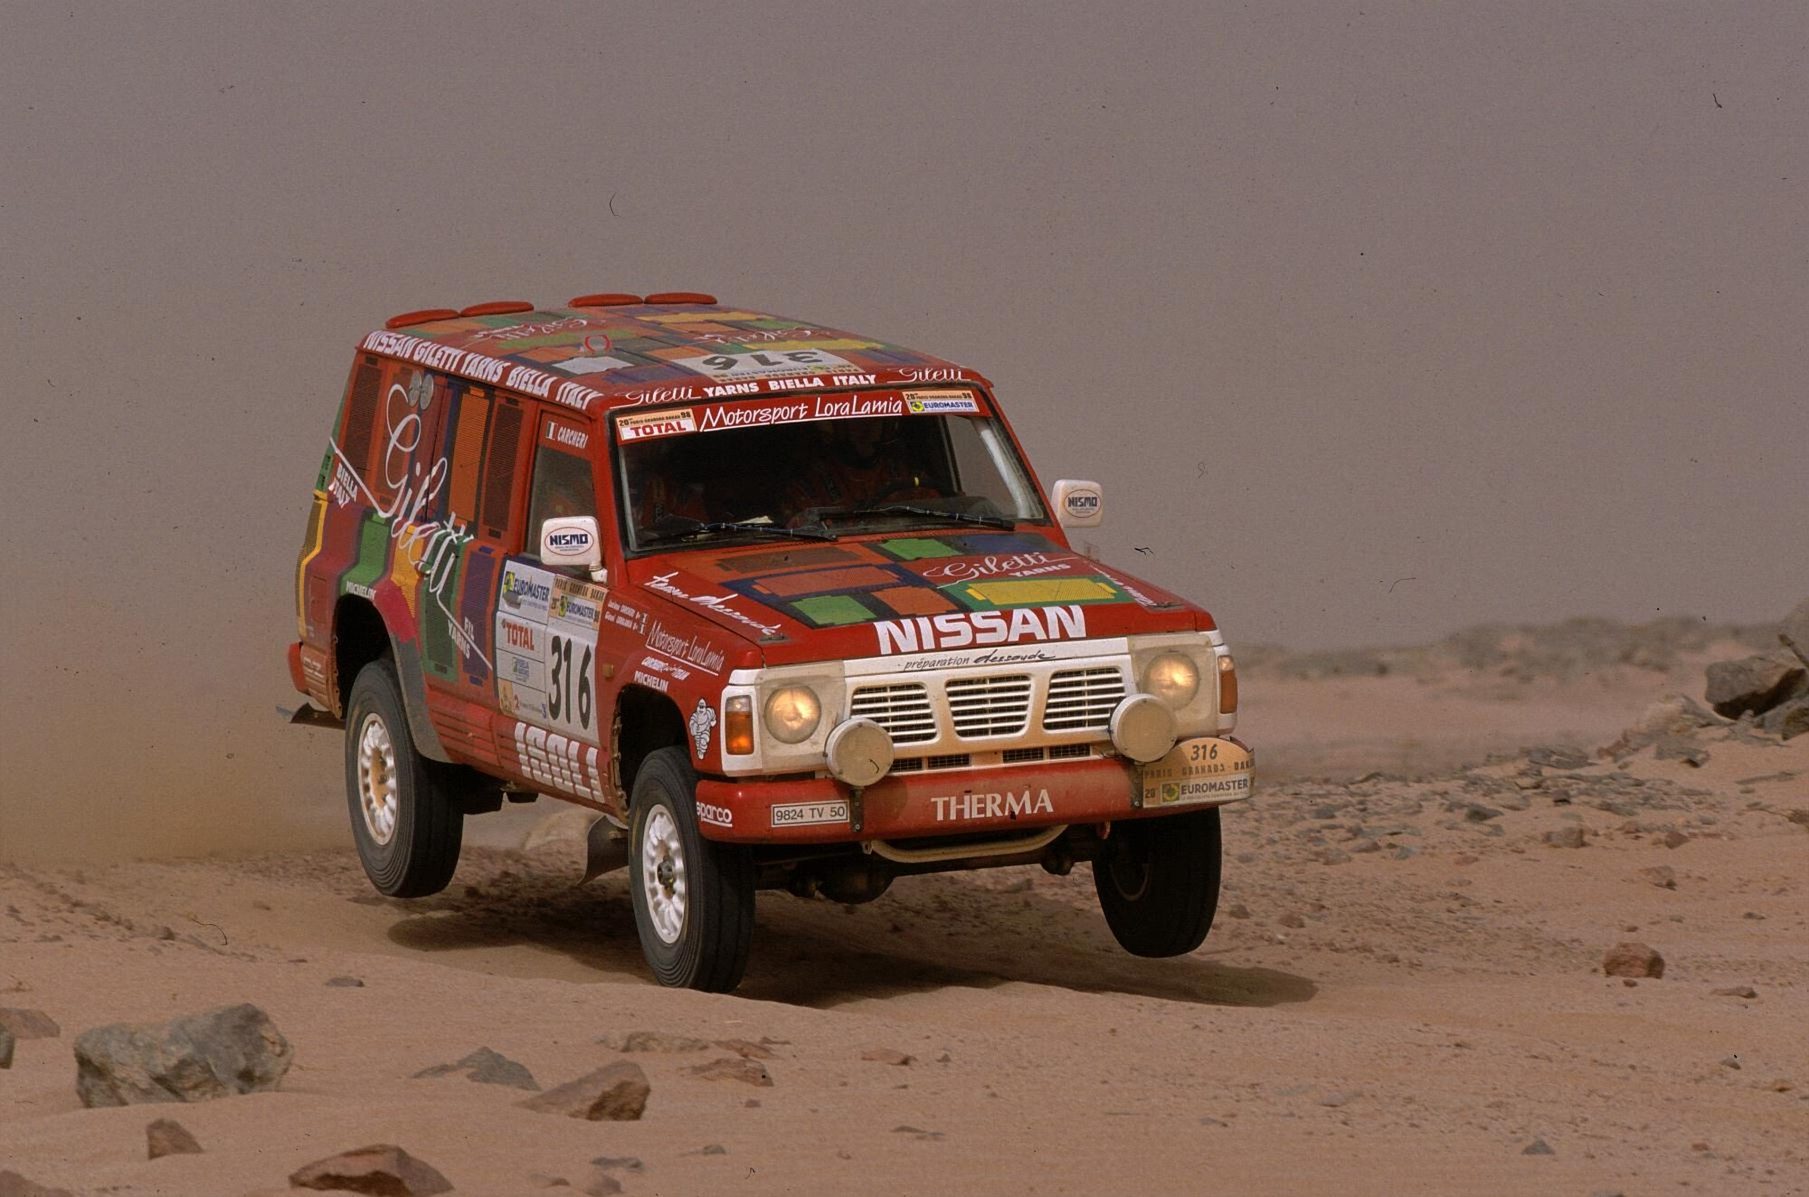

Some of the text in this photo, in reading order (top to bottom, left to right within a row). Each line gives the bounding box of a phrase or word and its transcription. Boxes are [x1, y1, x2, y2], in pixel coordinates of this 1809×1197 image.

[363, 330, 424, 358] NISSAN
[413, 341, 468, 372] GILETTI
[460, 352, 511, 383] YARNS
[505, 366, 558, 398] BIELLA
[555, 382, 604, 410] ITALY
[703, 383, 760, 397] YARNS
[768, 377, 824, 391] BIELLA
[833, 375, 876, 386] ITALY
[630, 421, 686, 436] TOTAL
[700, 405, 808, 432] Motorsport
[1068, 496, 1098, 507] NISMO
[550, 534, 588, 546] NISMO
[923, 552, 1079, 589] Giletti
[1008, 563, 1071, 577] YARNS
[346, 581, 376, 600] MICHELIN
[514, 578, 550, 601] EUROMASTER
[567, 602, 594, 619] EUROMASTER
[506, 622, 534, 651] TOTAL
[873, 604, 1087, 655] NISSAN
[904, 655, 970, 670] préparation
[549, 635, 591, 730] 316
[634, 670, 669, 693] MICHELIN
[1191, 744, 1218, 761] 316
[1181, 779, 1248, 795] EUROMASTER
[697, 801, 733, 823] sparco
[776, 806, 845, 821] 9824 TV 50
[931, 789, 1054, 821] THERMA
